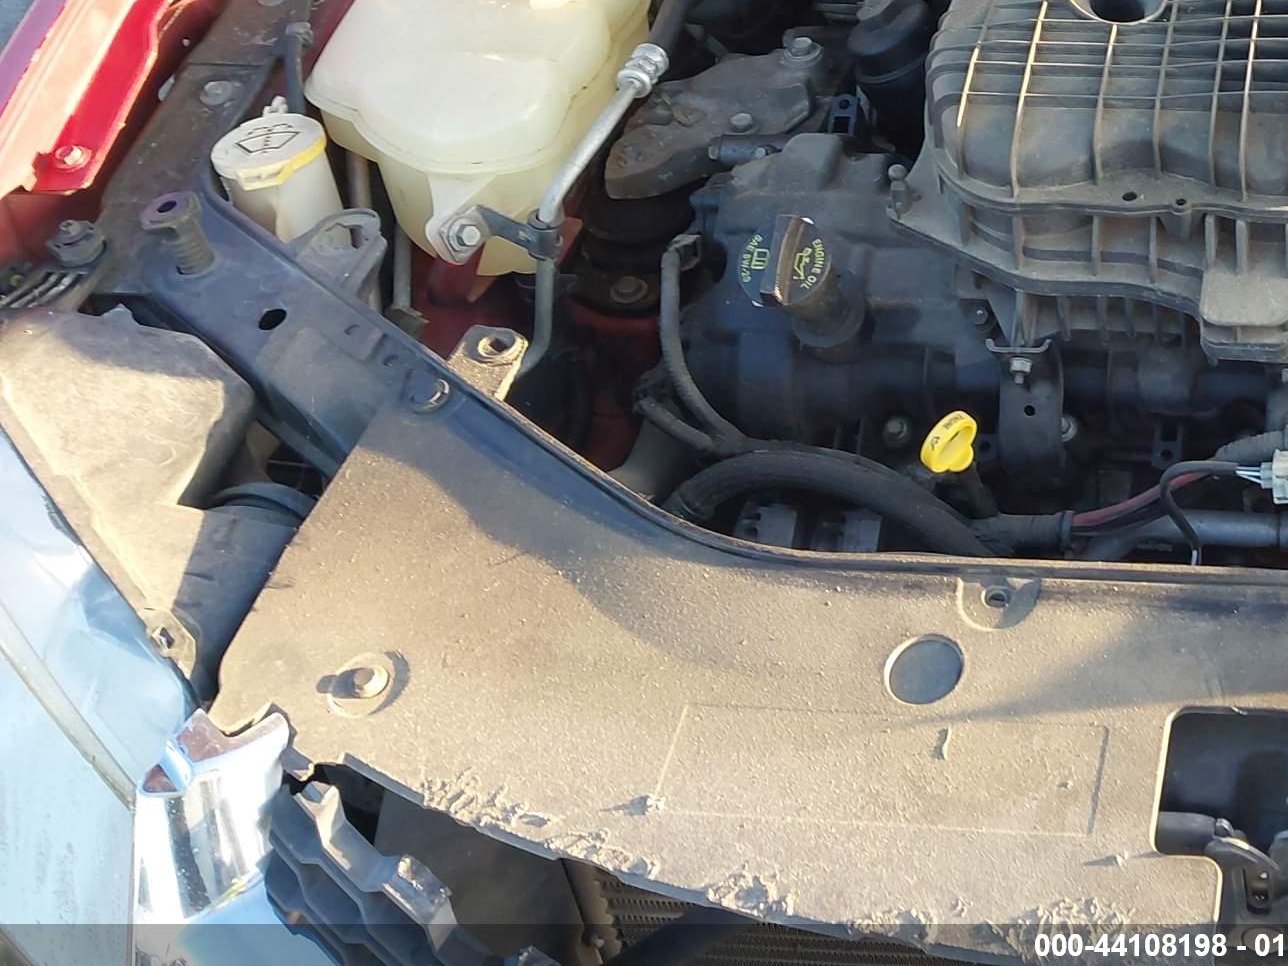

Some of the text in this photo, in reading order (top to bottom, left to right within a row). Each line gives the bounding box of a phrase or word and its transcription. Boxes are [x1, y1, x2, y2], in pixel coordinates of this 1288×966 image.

[745, 234, 763, 252] SAE
[799, 238, 825, 290] ENGINE OIL
